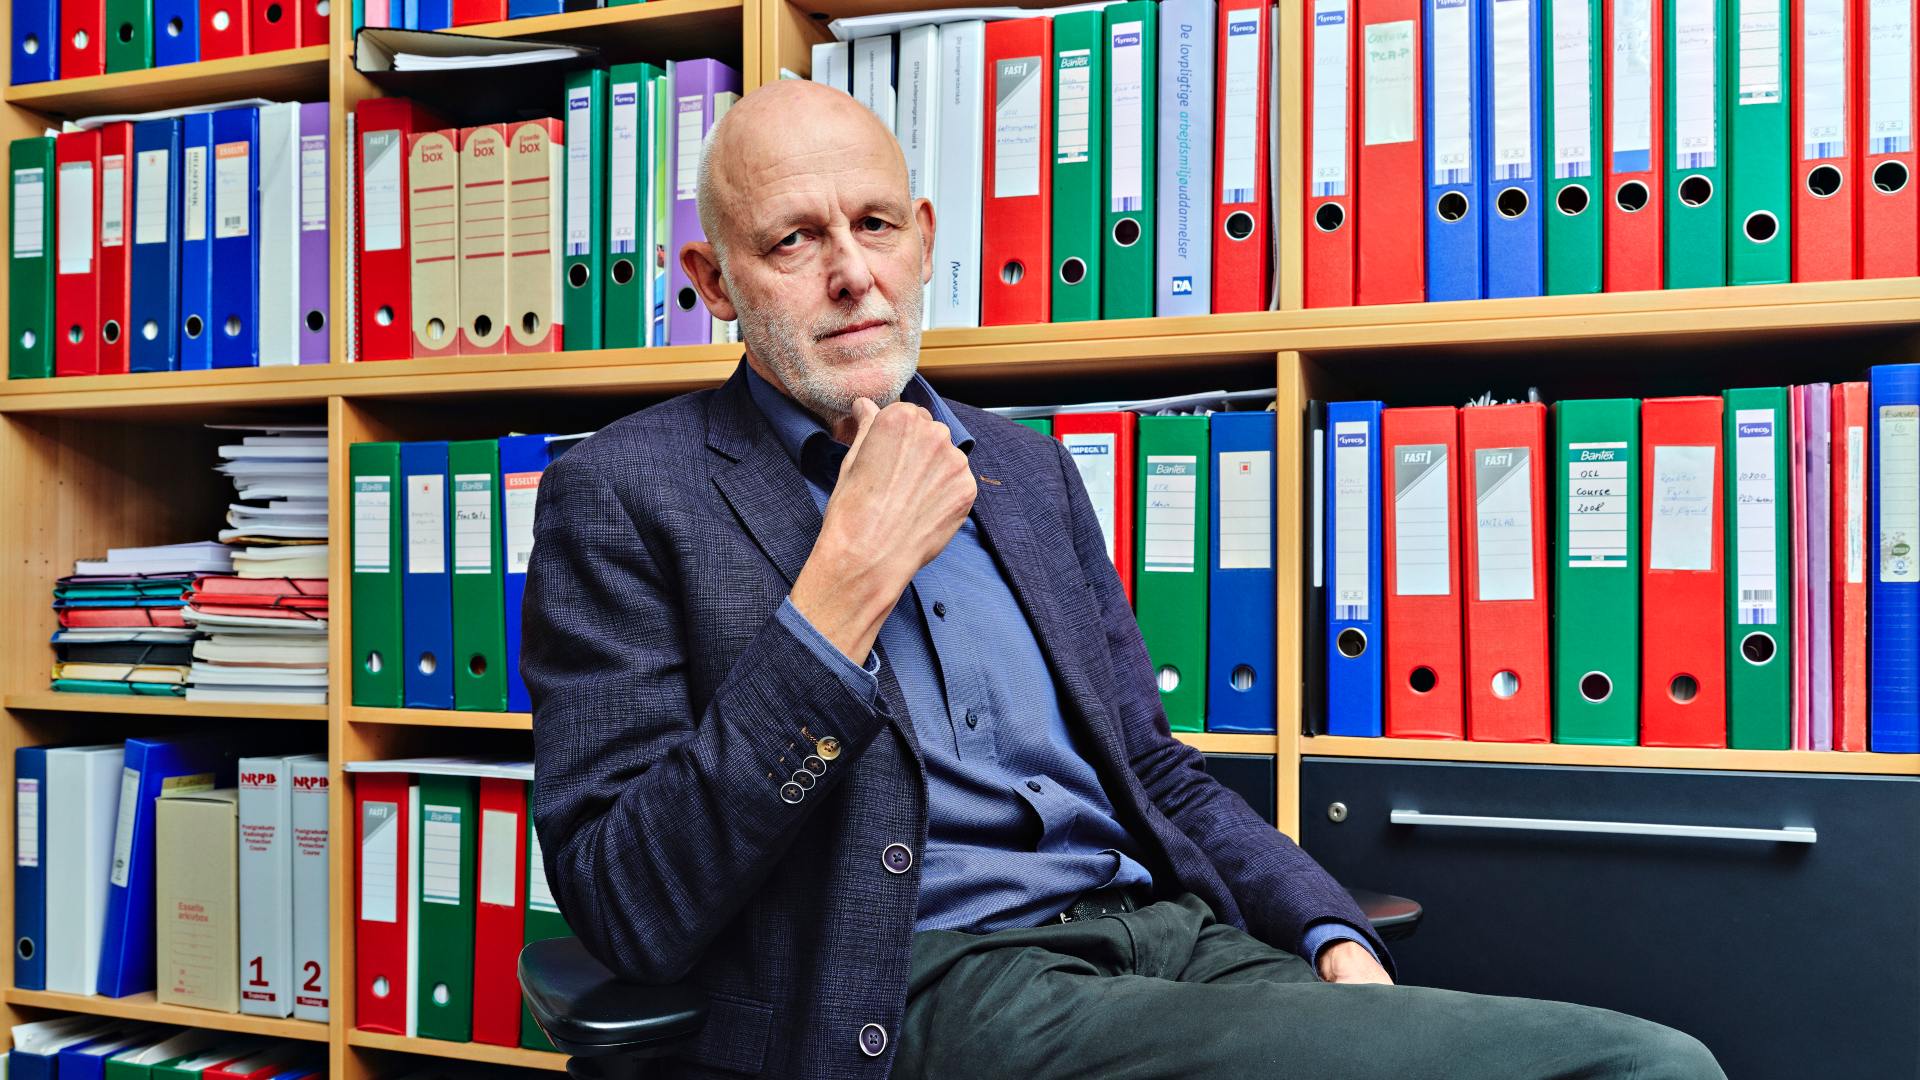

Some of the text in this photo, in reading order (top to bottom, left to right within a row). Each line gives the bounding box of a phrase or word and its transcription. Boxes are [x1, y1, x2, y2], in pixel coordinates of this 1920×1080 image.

[1061, 57, 1088, 68] Bantex
[519, 142, 541, 154] box
[1175, 24, 1192, 260] De lovpligtige arbejdsmiljøuddannelser
[421, 151, 443, 163] box
[474, 146, 495, 158] box
[1173, 280, 1192, 292] DA
[1740, 425, 1770, 434] Lyreco
[1339, 436, 1365, 445] Lyreco
[1581, 450, 1614, 461] Bantex
[1156, 464, 1186, 474] Bantex
[1576, 488, 1611, 496] Course
[249, 956, 269, 987] 1
[303, 961, 322, 992] 2
